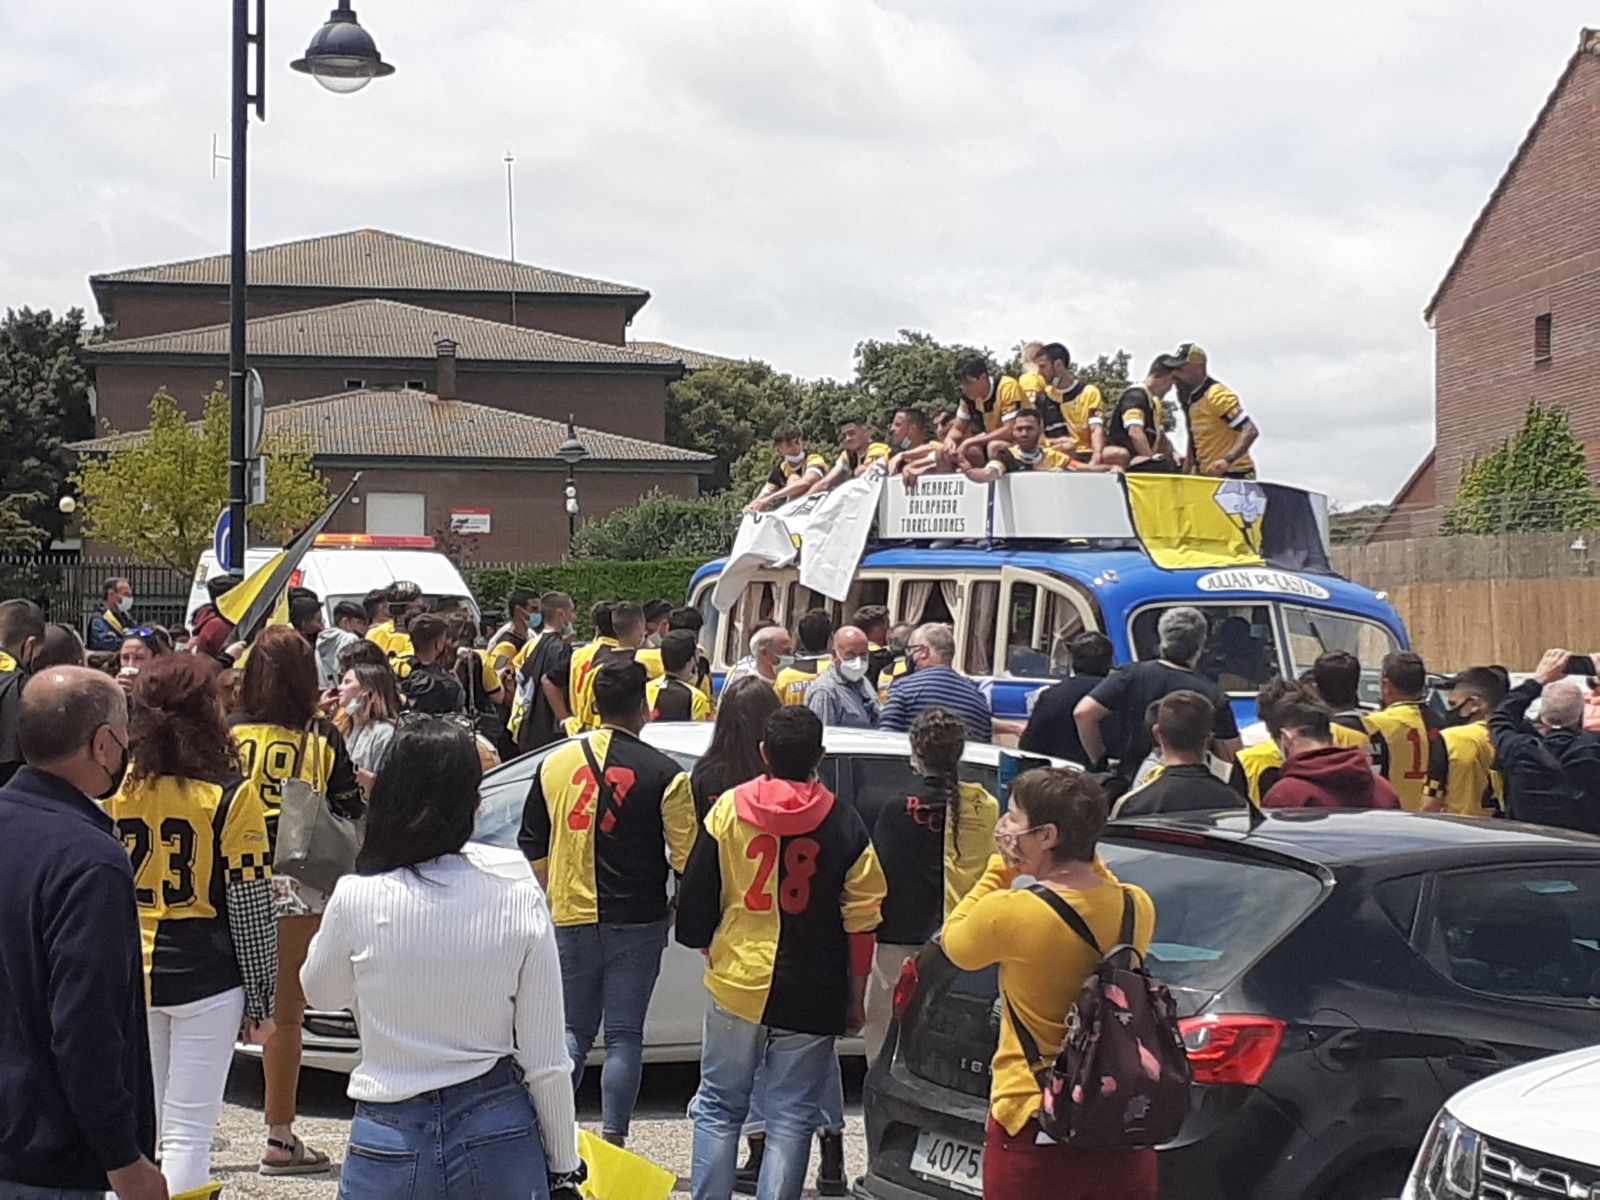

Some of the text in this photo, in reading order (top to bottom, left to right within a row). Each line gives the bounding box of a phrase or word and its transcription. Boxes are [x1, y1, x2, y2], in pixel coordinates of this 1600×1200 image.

[901, 518, 966, 533] TORRELODONES
[909, 499, 958, 514] GALAPAGAR
[116, 816, 198, 909] 23
[744, 834, 821, 915] 28
[927, 1138, 982, 1179] 4075
